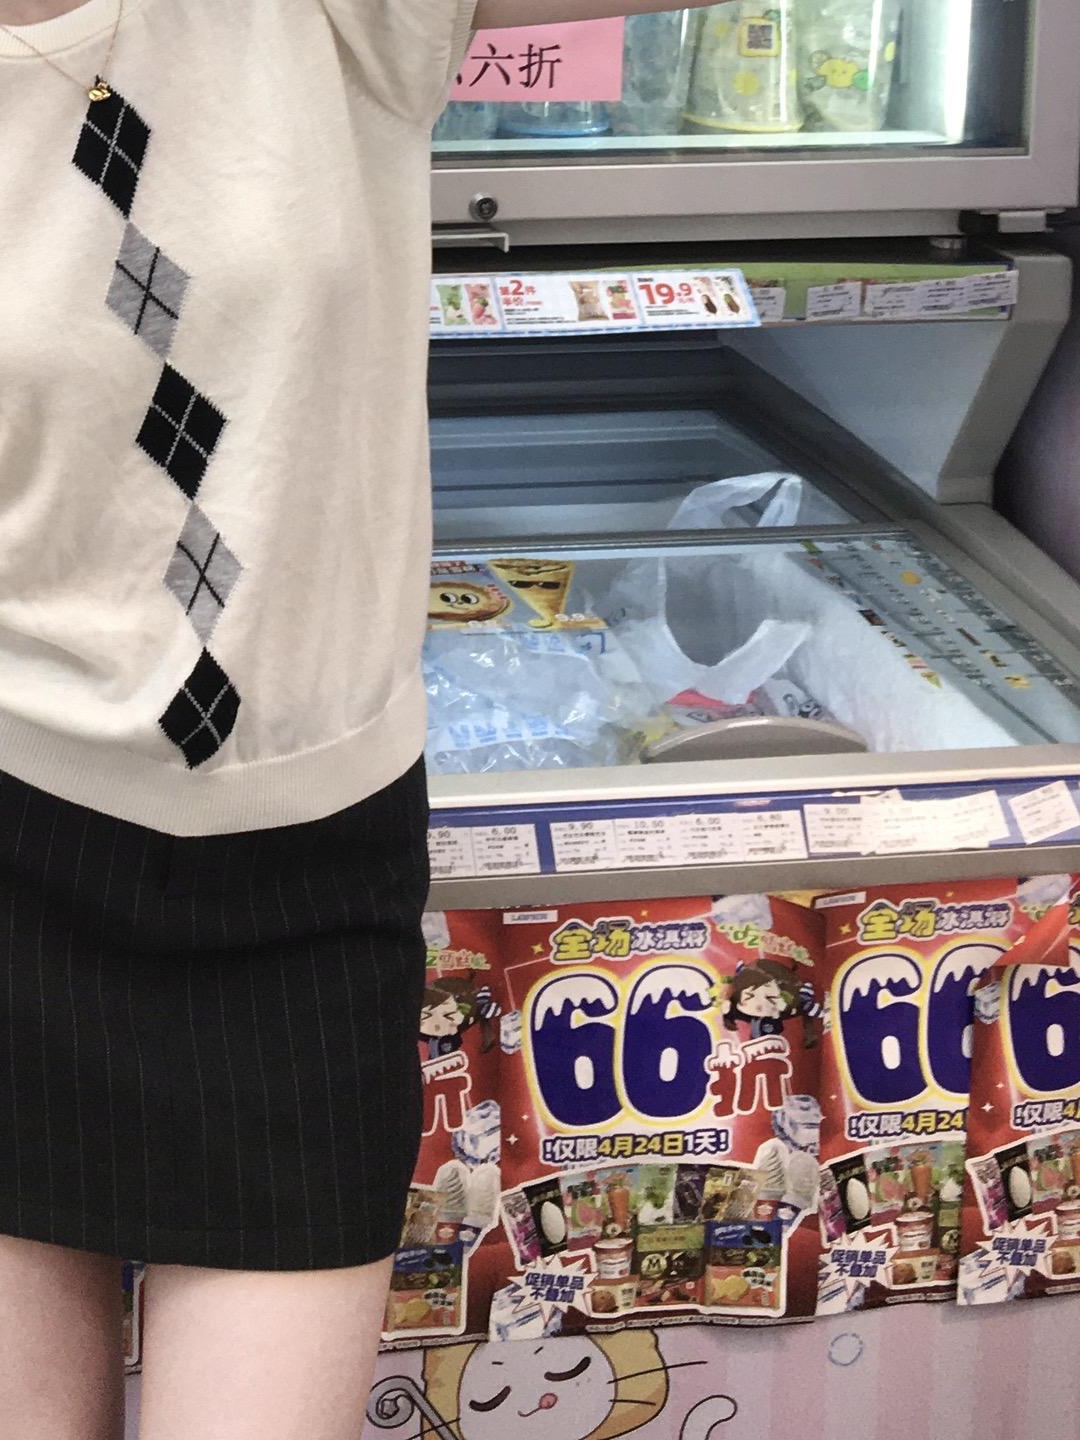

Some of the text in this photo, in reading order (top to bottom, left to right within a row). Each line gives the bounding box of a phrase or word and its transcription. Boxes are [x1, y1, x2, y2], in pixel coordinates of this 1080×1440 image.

[455, 42, 563, 90] 六折
[638, 282, 693, 306] 19.9
[860, 901, 1012, 942] 全场冰淇淋
[552, 918, 709, 962] 全场冰淇淋
[992, 1237, 1047, 1254] 促销单品
[830, 1247, 887, 1265] 促销单品
[997, 1250, 1039, 1267] 不叠加
[836, 1261, 878, 1278] 不叠加
[525, 1271, 585, 1290] 促销单品
[529, 1287, 576, 1304] 不叠加
